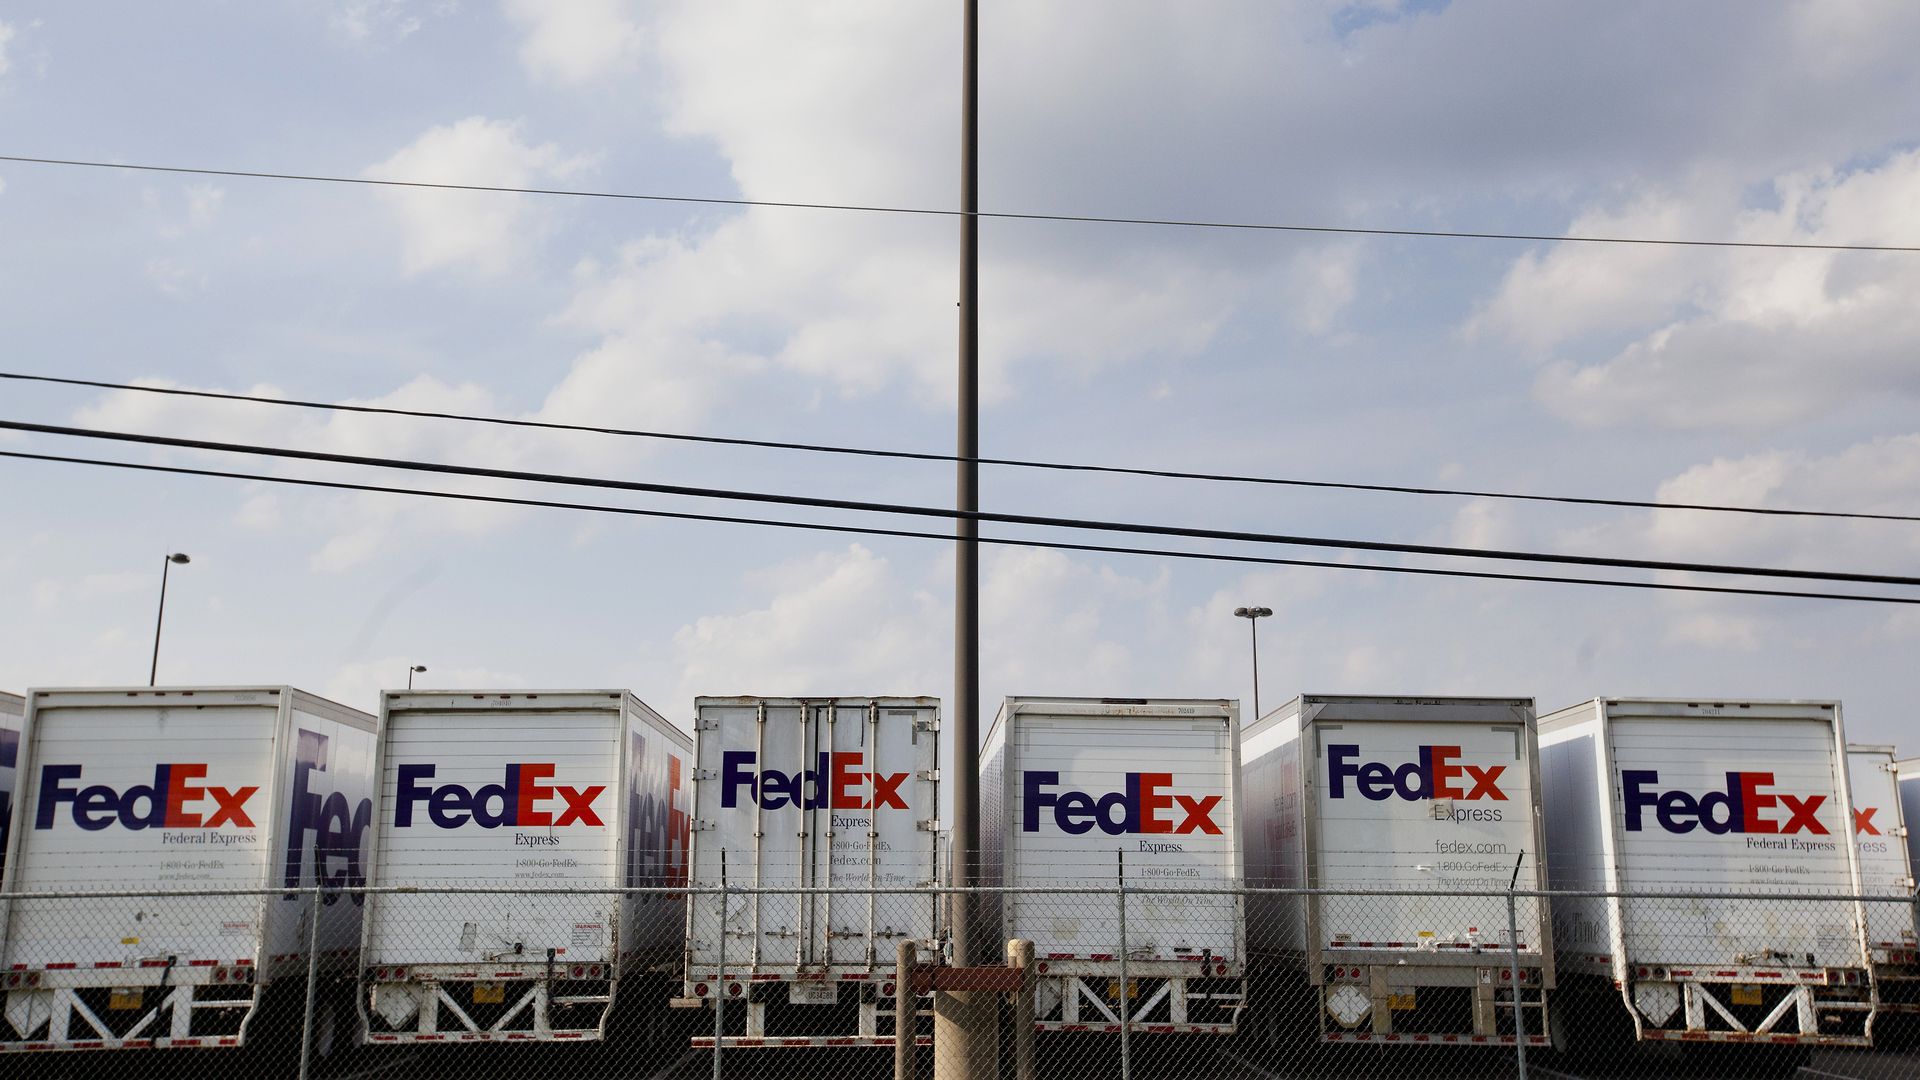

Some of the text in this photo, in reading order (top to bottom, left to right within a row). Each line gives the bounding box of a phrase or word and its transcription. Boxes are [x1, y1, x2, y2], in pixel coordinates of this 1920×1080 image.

[721, 751, 910, 810] FedEx
[1327, 744, 1509, 801] FedEx
[35, 763, 260, 831] FedEx
[394, 763, 607, 829] FedEx
[1023, 771, 1224, 835] FedEx
[1434, 804, 1502, 824] Express
[1621, 770, 1831, 835] FedEx
[283, 728, 374, 906] Fed
[831, 815, 871, 829] Expres
[162, 832, 257, 846] Federal Express
[515, 833, 560, 847] Express
[1139, 840, 1183, 854] Express
[1435, 840, 1507, 854] fedex.com
[1746, 837, 1836, 852] Federal Express
